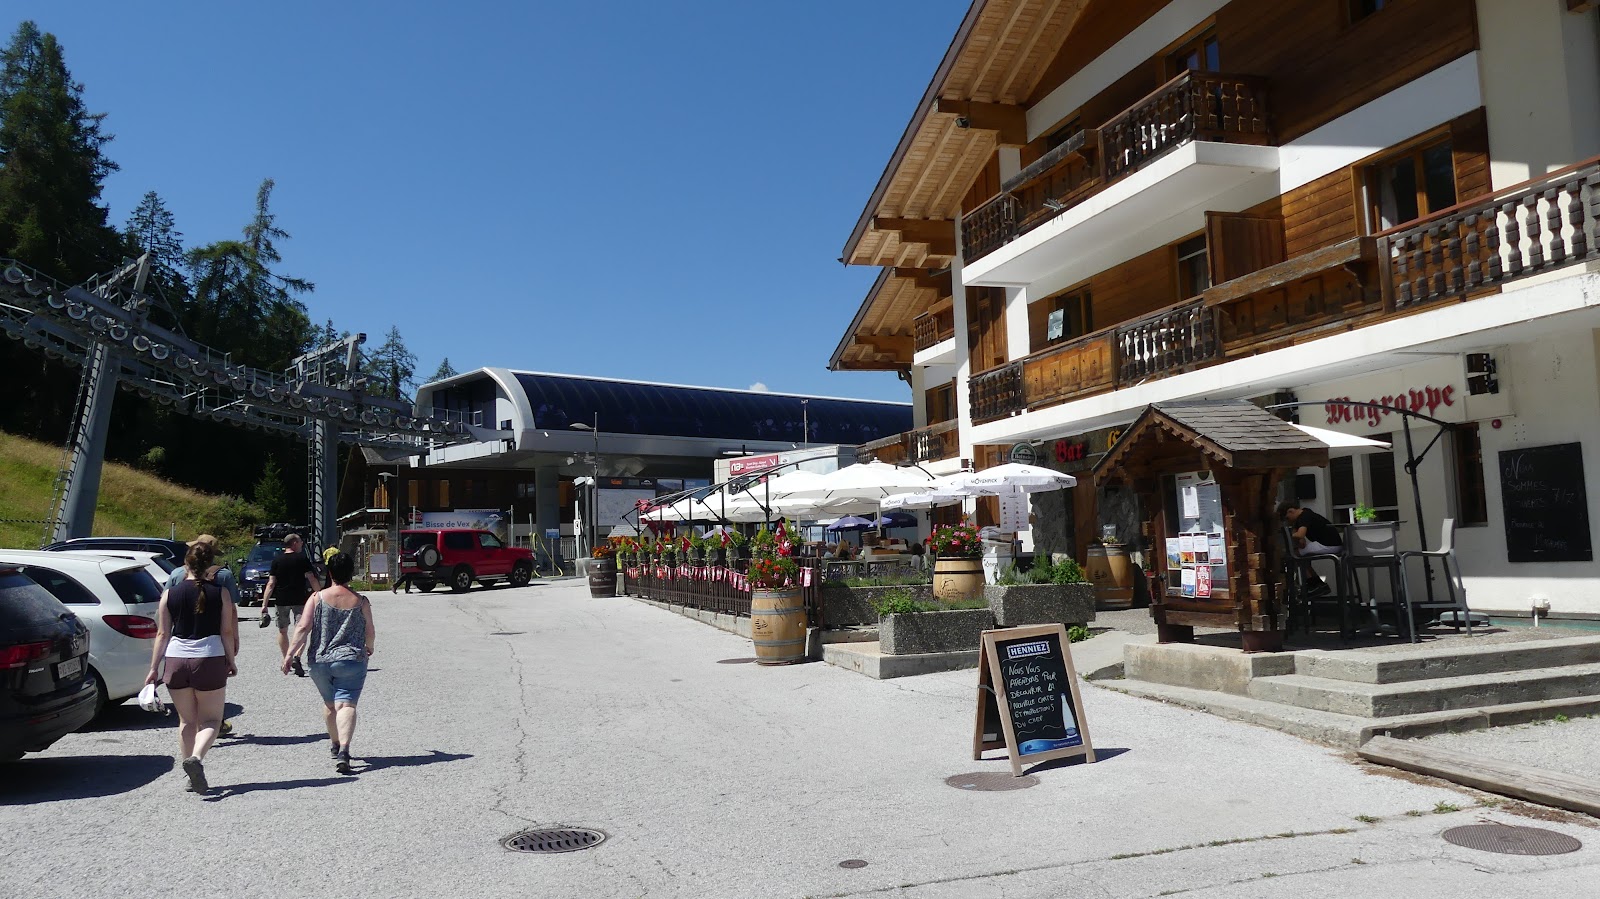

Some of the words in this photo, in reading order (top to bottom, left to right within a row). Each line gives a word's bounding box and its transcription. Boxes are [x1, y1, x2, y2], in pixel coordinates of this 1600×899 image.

[1055, 439, 1085, 463] Bar
[1010, 644, 1047, 656] HENNIEZ
[1038, 695, 1054, 704] CARTE
[1015, 721, 1026, 729] DU
